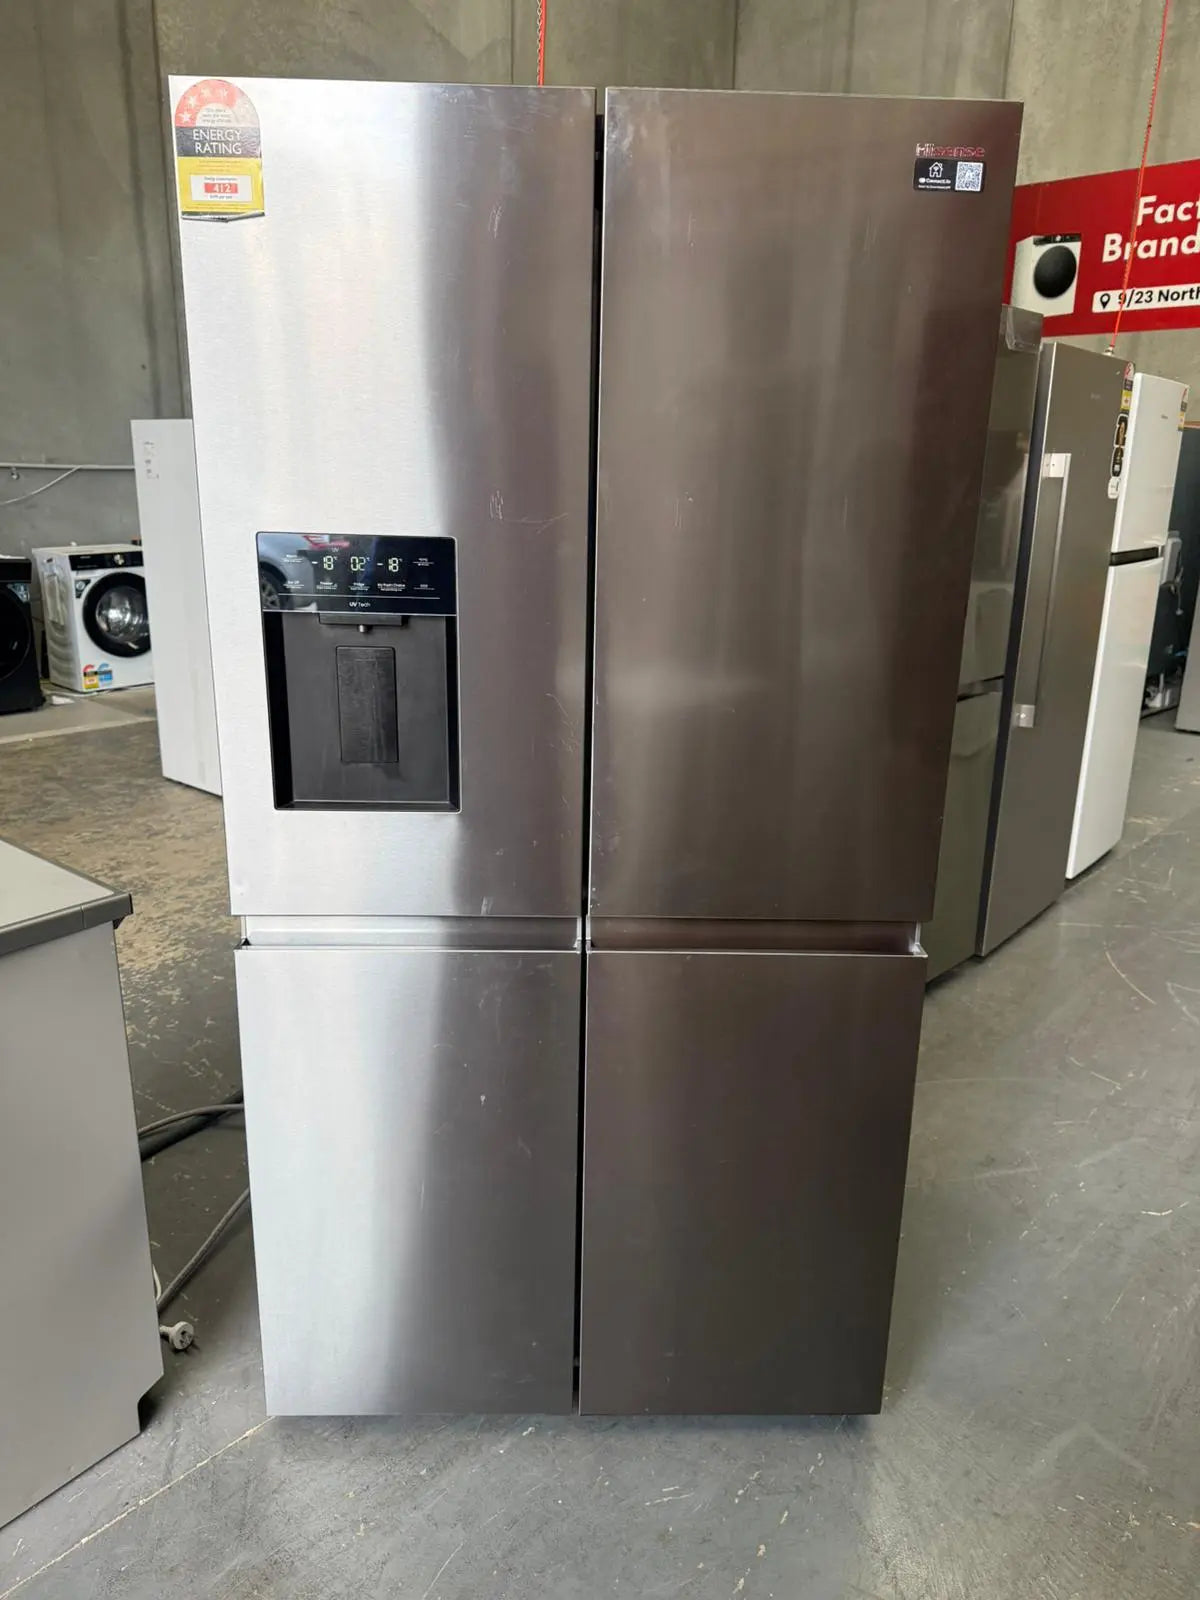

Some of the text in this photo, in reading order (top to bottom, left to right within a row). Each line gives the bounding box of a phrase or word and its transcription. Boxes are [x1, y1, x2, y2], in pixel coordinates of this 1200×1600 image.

[193, 129, 241, 141] ENERGY
[194, 142, 242, 154] RATING
[916, 143, 985, 157] Hisense
[213, 183, 232, 193] 412
[1102, 220, 1200, 263] Brand
[1118, 289, 1153, 308] 9/23
